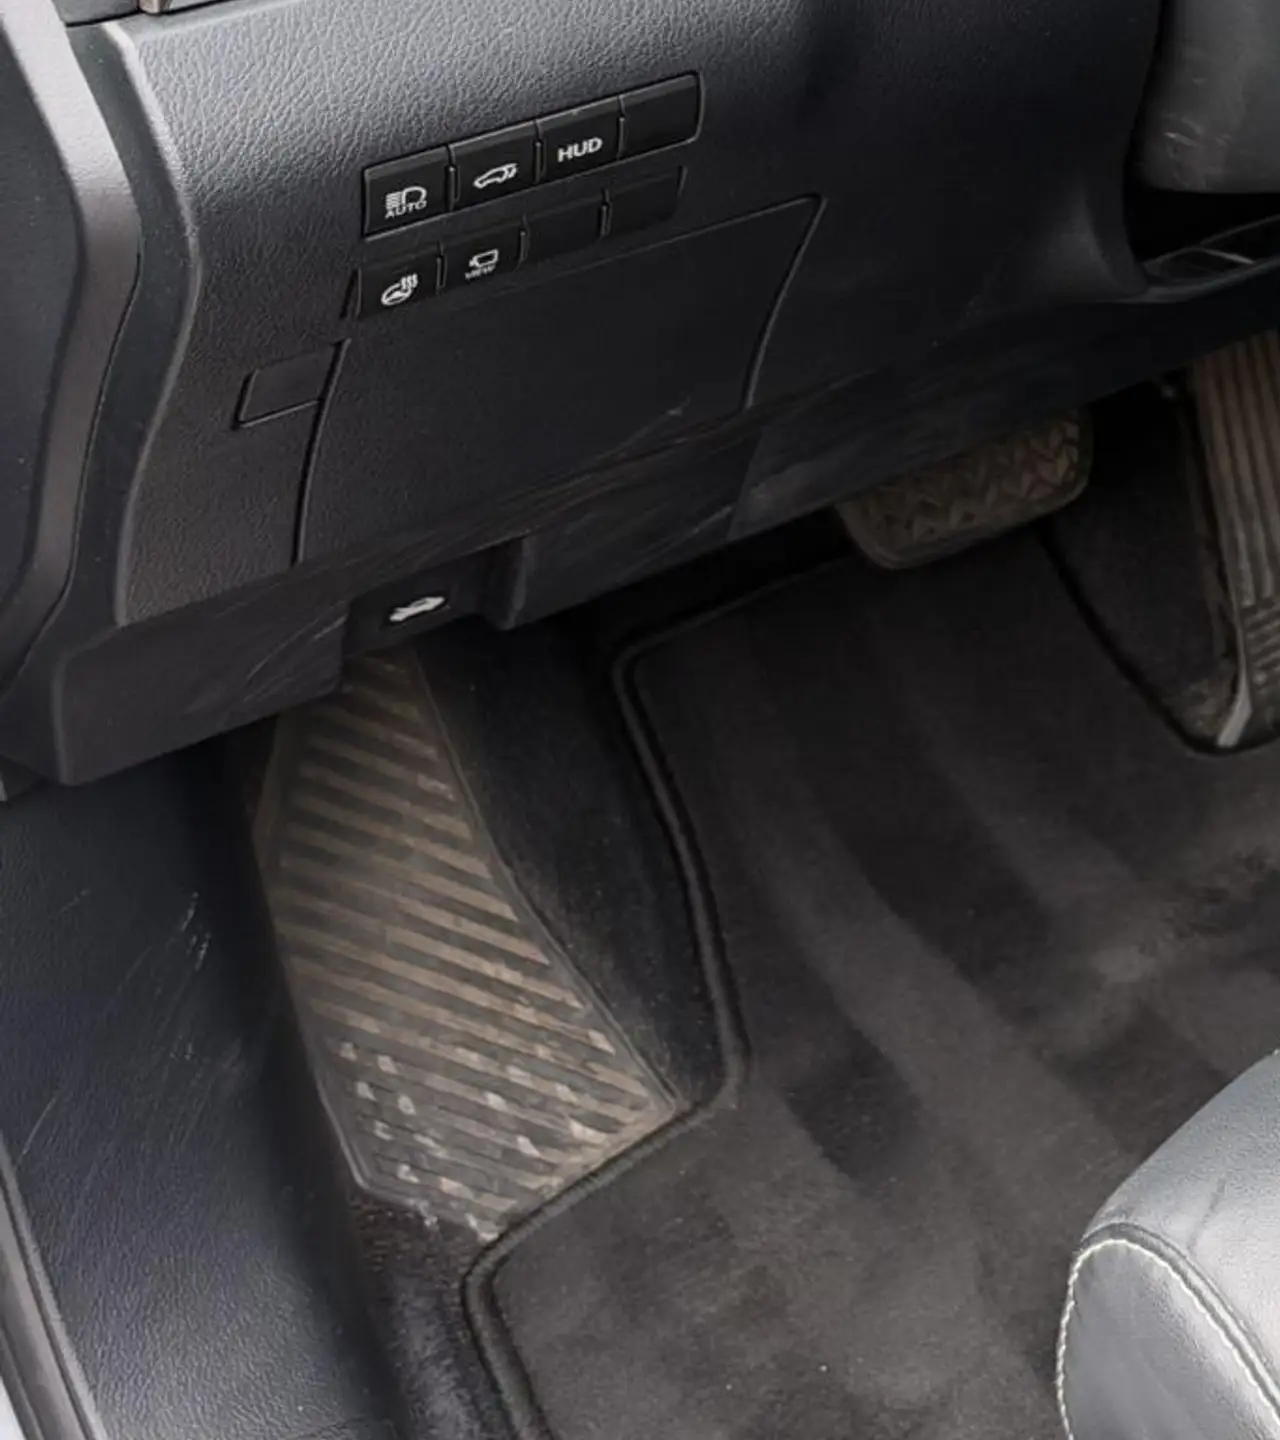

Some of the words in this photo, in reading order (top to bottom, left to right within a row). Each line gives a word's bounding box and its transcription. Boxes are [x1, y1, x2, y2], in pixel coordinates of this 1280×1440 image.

[557, 136, 604, 163] HUD
[385, 200, 428, 220] AUTO
[465, 264, 497, 280] VIEW
